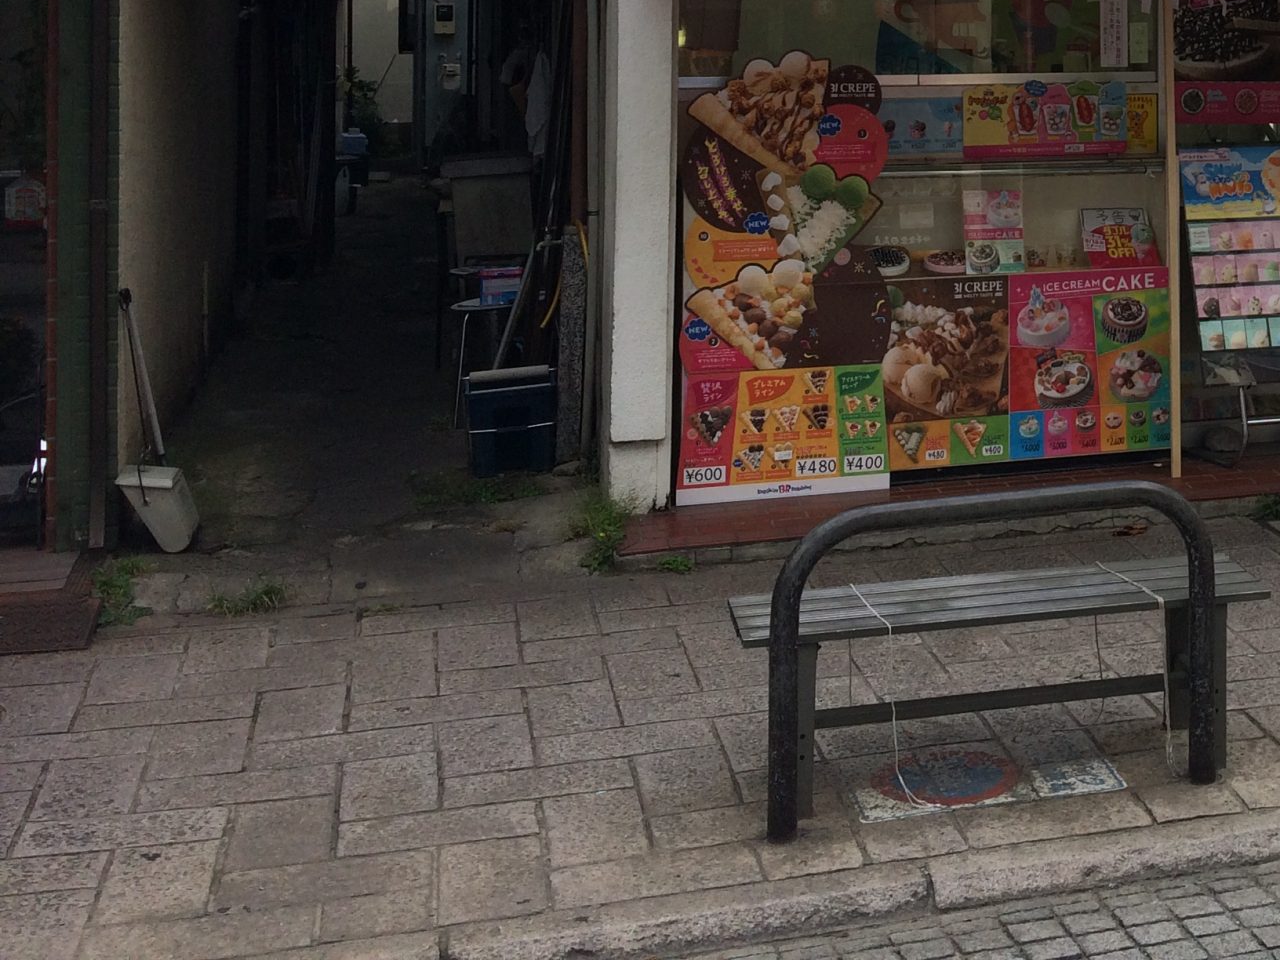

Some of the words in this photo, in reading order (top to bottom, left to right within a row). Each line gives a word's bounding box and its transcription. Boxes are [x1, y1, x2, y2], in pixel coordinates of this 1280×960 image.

[840, 82, 877, 93] CREPE
[819, 121, 839, 130] NEW
[748, 220, 767, 228] NEW
[964, 280, 1004, 293] CREPE
[1042, 282, 1061, 293] ICE
[1061, 279, 1101, 291] CREAM
[1102, 272, 1156, 292] CAKE
[688, 325, 709, 334] NEW
[752, 379, 787, 389] プレミアム
[703, 393, 722, 403] ライン
[754, 388, 775, 398] ライン
[927, 450, 945, 460] ¥480
[984, 445, 1002, 455] ¥400
[797, 459, 837, 475] ¥480
[846, 455, 883, 471] ¥400
[685, 467, 723, 483] ¥600
